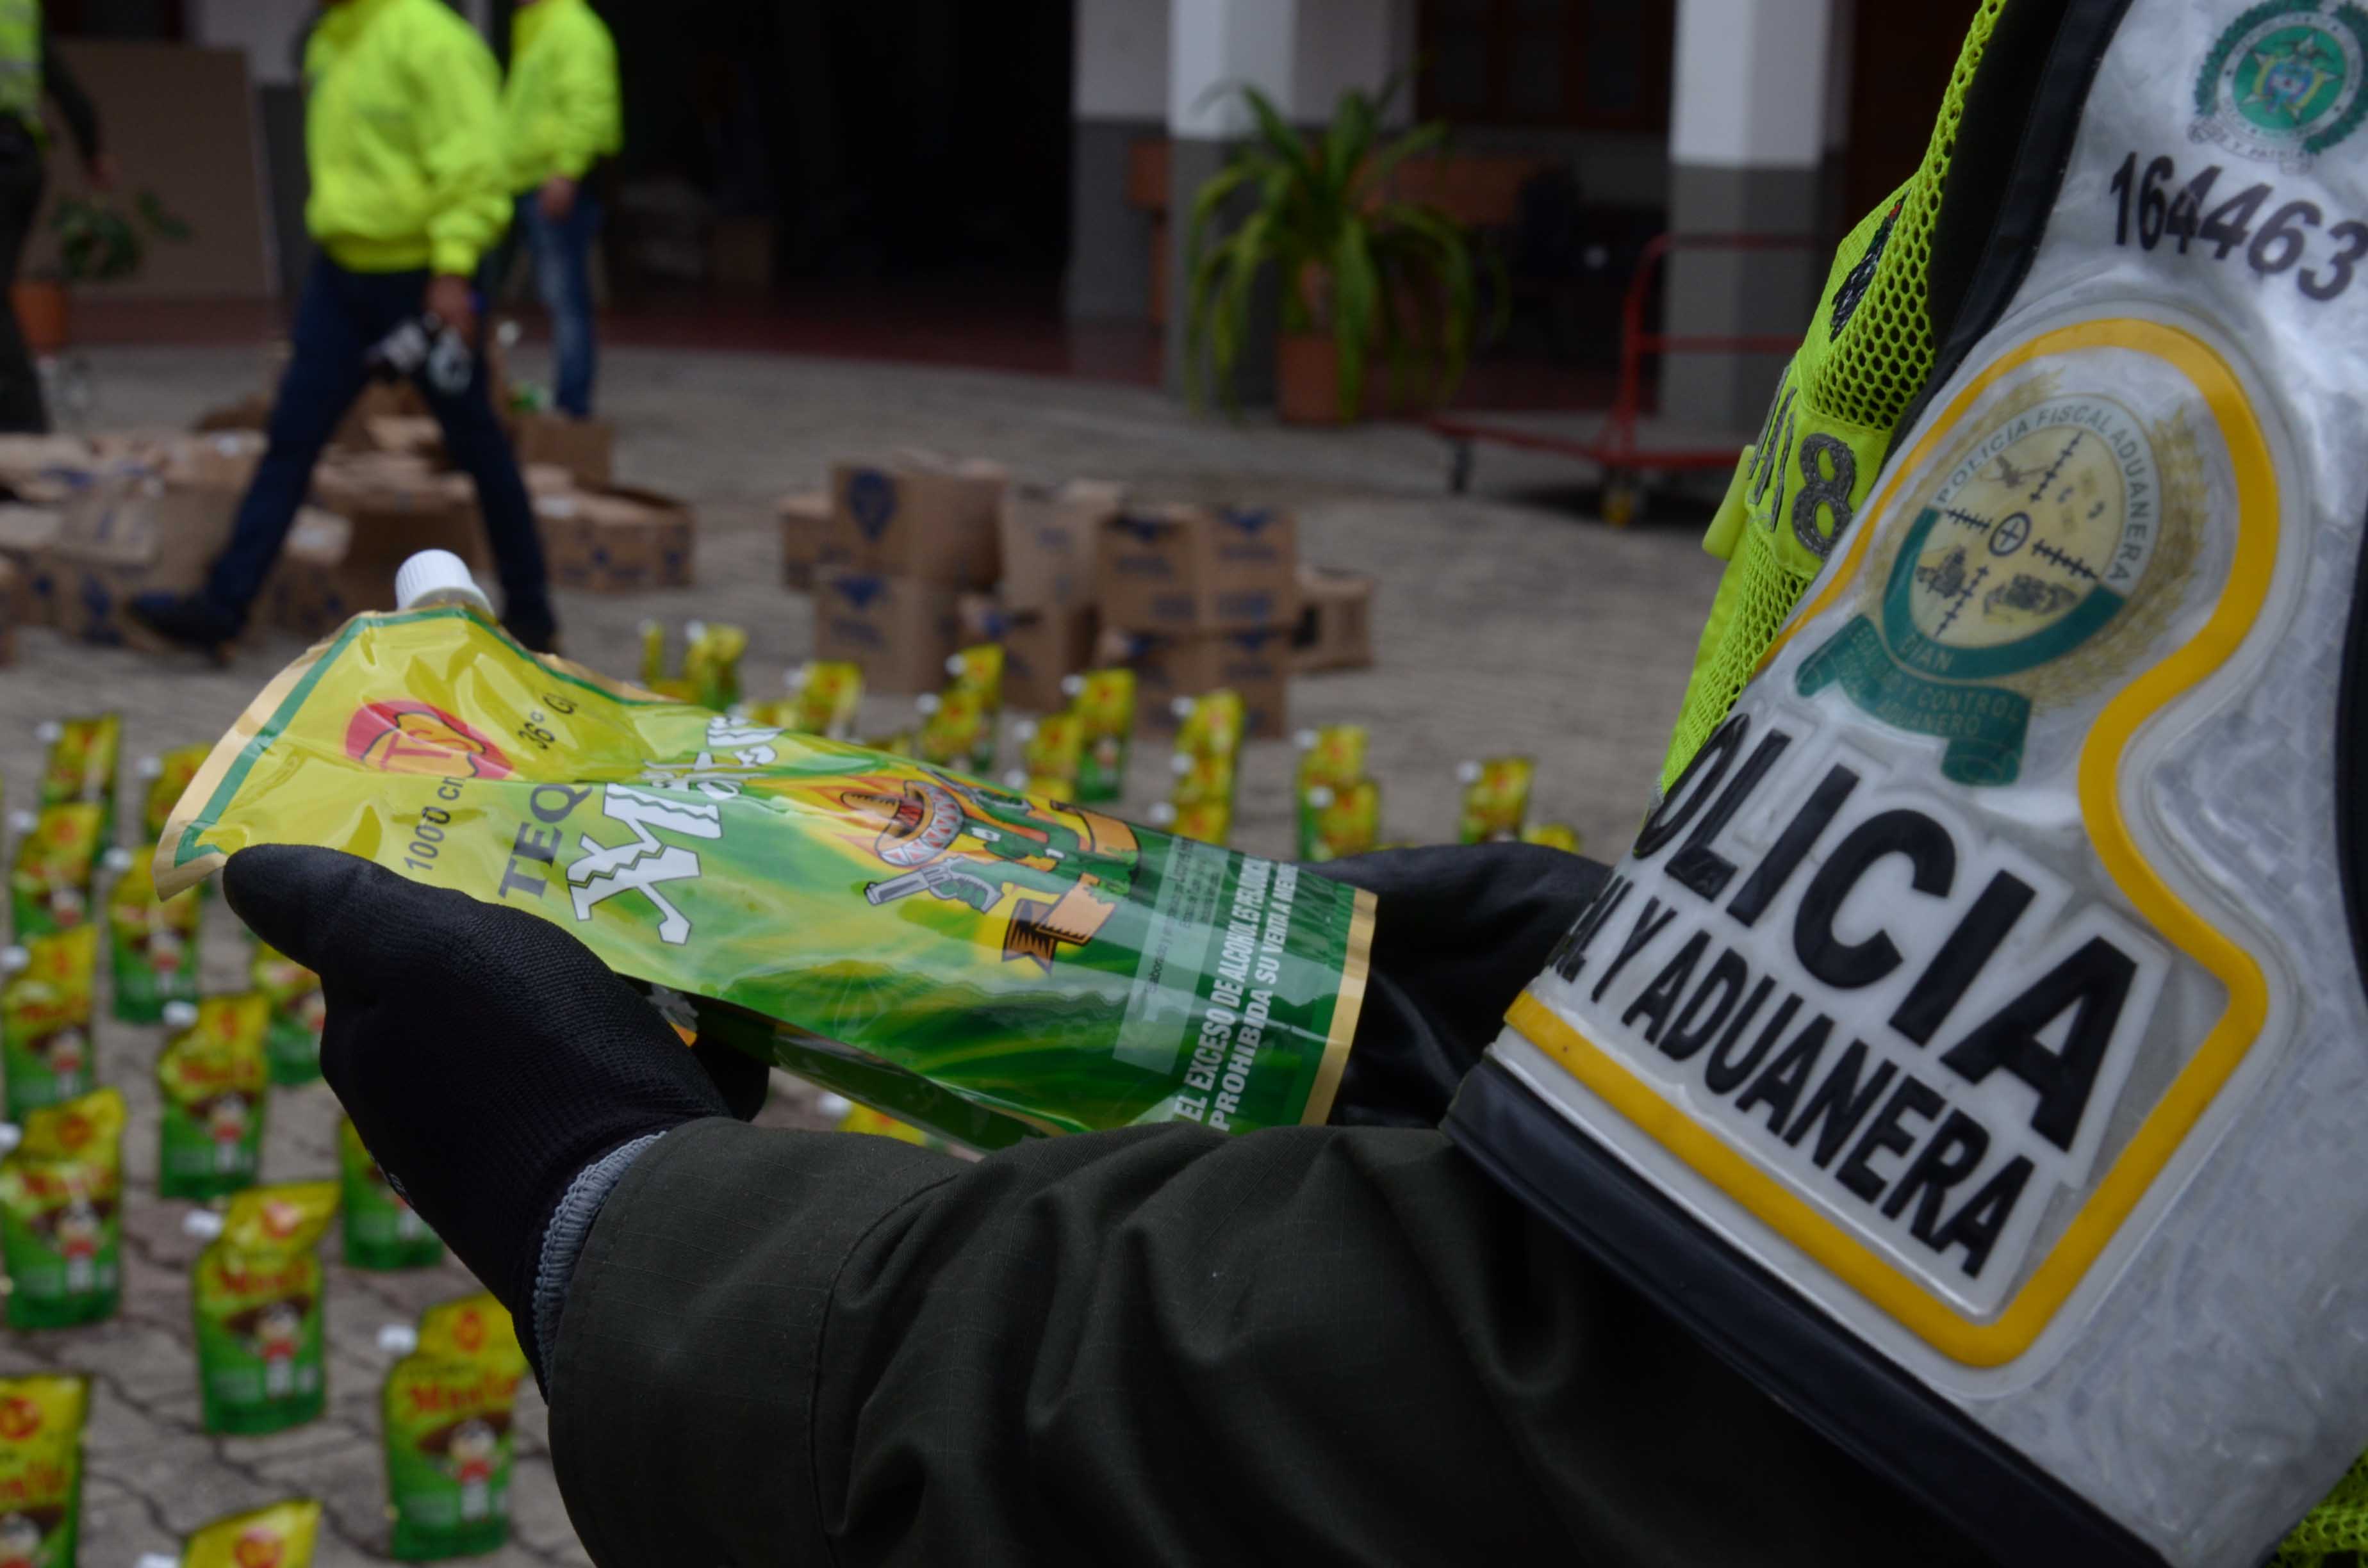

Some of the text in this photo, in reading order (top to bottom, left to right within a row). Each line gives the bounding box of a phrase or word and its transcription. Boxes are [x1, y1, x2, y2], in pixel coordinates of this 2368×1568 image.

[2109, 151, 2368, 301] 164463
[1936, 404, 2149, 582] POLICIA FISCAL ADUANERA
[1916, 685, 2021, 724] CONTROL
[404, 806, 451, 871] 1000
[498, 783, 594, 899] TEQ
[1262, 911, 1290, 959] VENTA
[1270, 902, 1292, 915] A
[1632, 712, 2138, 1154] OLICIA
[1218, 917, 1258, 987] ALCOHOL
[1255, 955, 1281, 985] SU
[1591, 896, 1678, 1003] Y
[1209, 979, 1244, 1009] DE
[1185, 1008, 1237, 1091] EXCESO
[1209, 990, 1273, 1132] PROHIBIDA
[1174, 1095, 1208, 1122] EL
[1621, 929, 2035, 1278] ADUANERA
